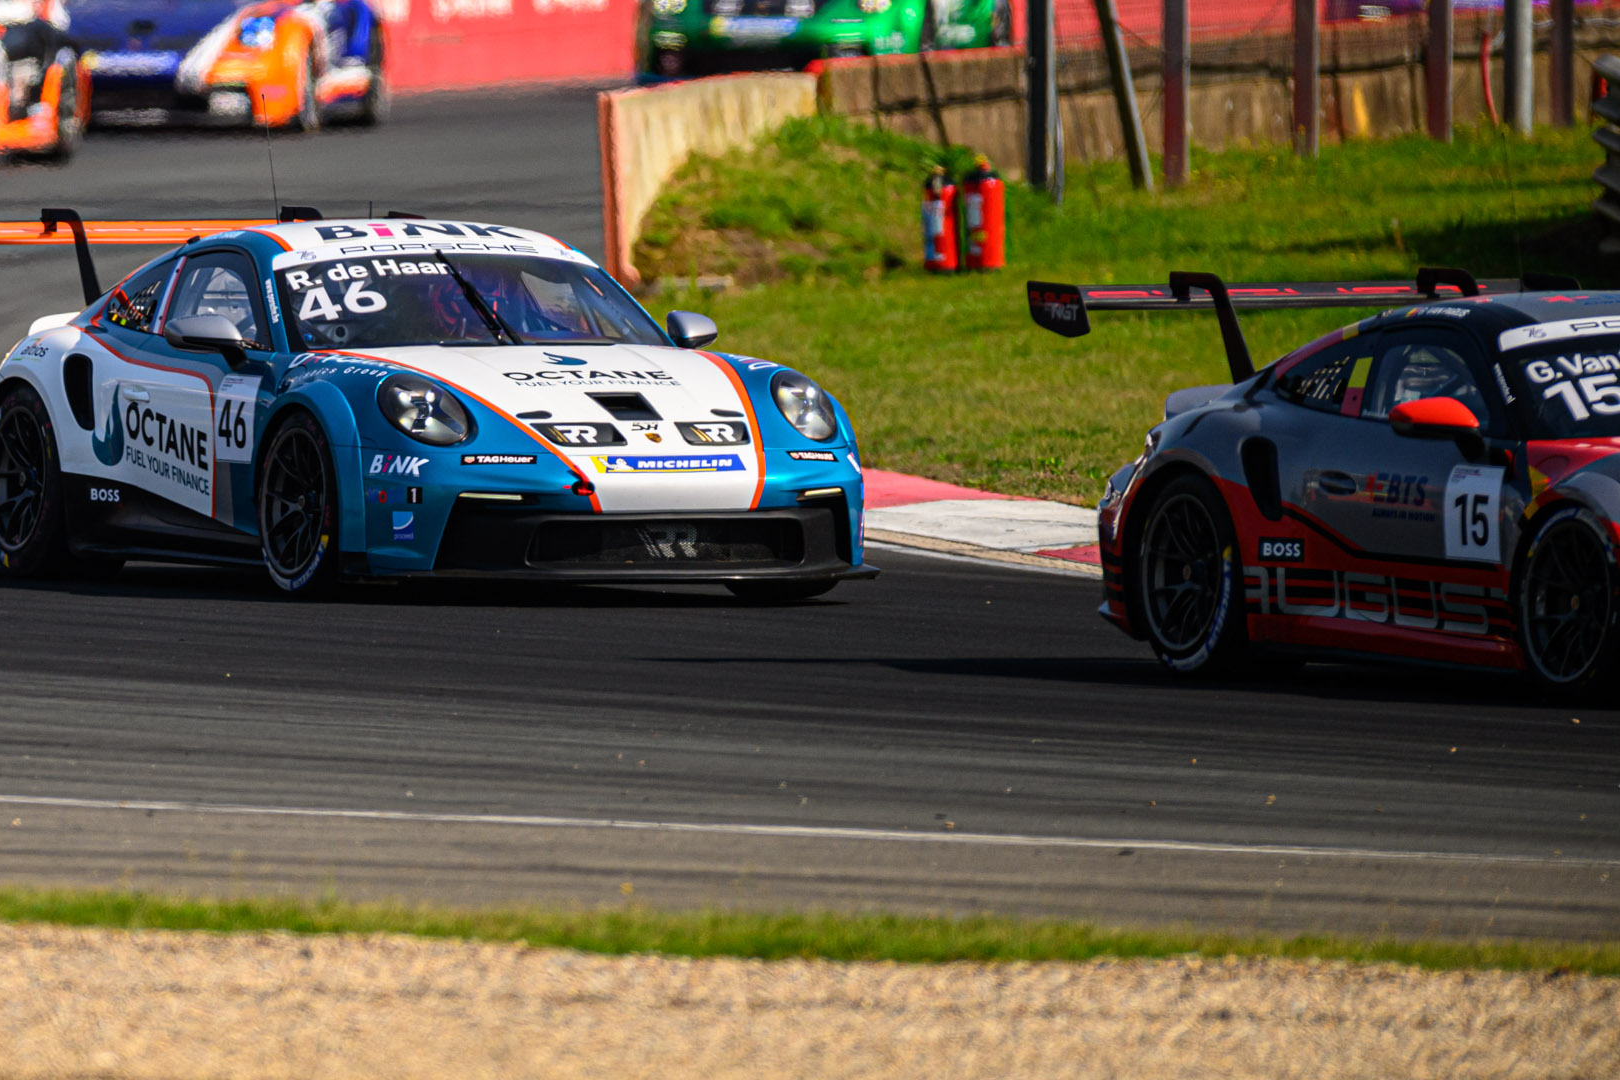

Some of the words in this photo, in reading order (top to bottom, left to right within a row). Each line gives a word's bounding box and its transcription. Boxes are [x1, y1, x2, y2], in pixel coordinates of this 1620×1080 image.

[340, 242, 539, 255] PORSCHE
[285, 270, 323, 291] R.
[327, 262, 369, 281] de
[298, 279, 388, 322] 46
[343, 366, 388, 379] Group
[502, 370, 674, 381] OCTANE
[1542, 373, 1620, 421] 15
[125, 401, 209, 471] OCTANE
[218, 399, 247, 450] 46
[126, 446, 147, 469] FUEL
[147, 453, 170, 479] YOUR
[171, 464, 210, 496] FINANCE
[637, 458, 733, 469] MICHELIN
[90, 487, 120, 502] BOSS
[1454, 493, 1489, 547] 15
[1262, 541, 1301, 557] BOSS
